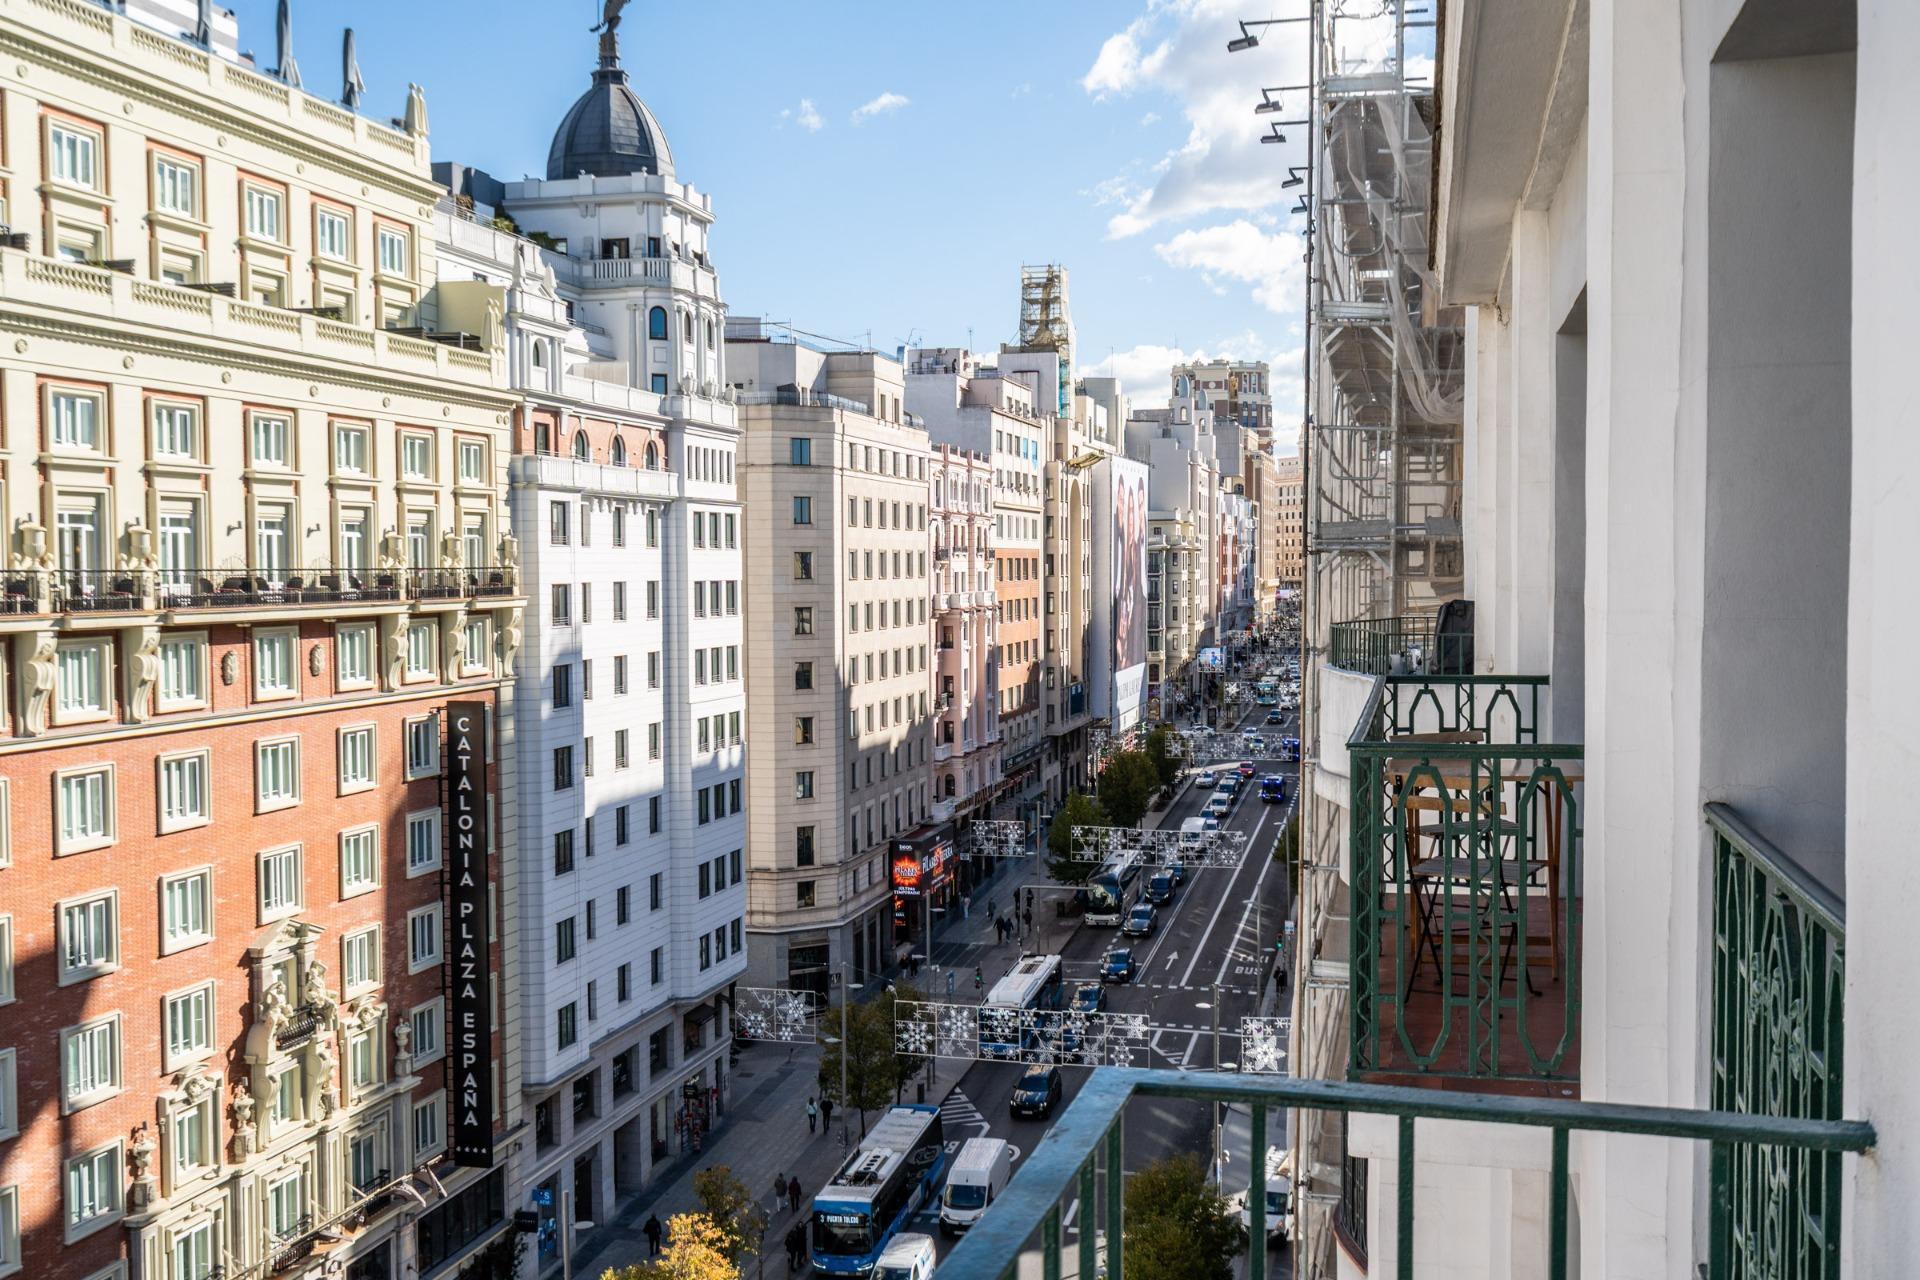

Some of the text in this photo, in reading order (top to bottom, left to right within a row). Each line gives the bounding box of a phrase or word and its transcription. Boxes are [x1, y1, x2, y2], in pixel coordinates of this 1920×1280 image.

[457, 717, 478, 1126] CATALONIA PLAZA ESPAÑA
[1235, 966, 1263, 976] BUS
